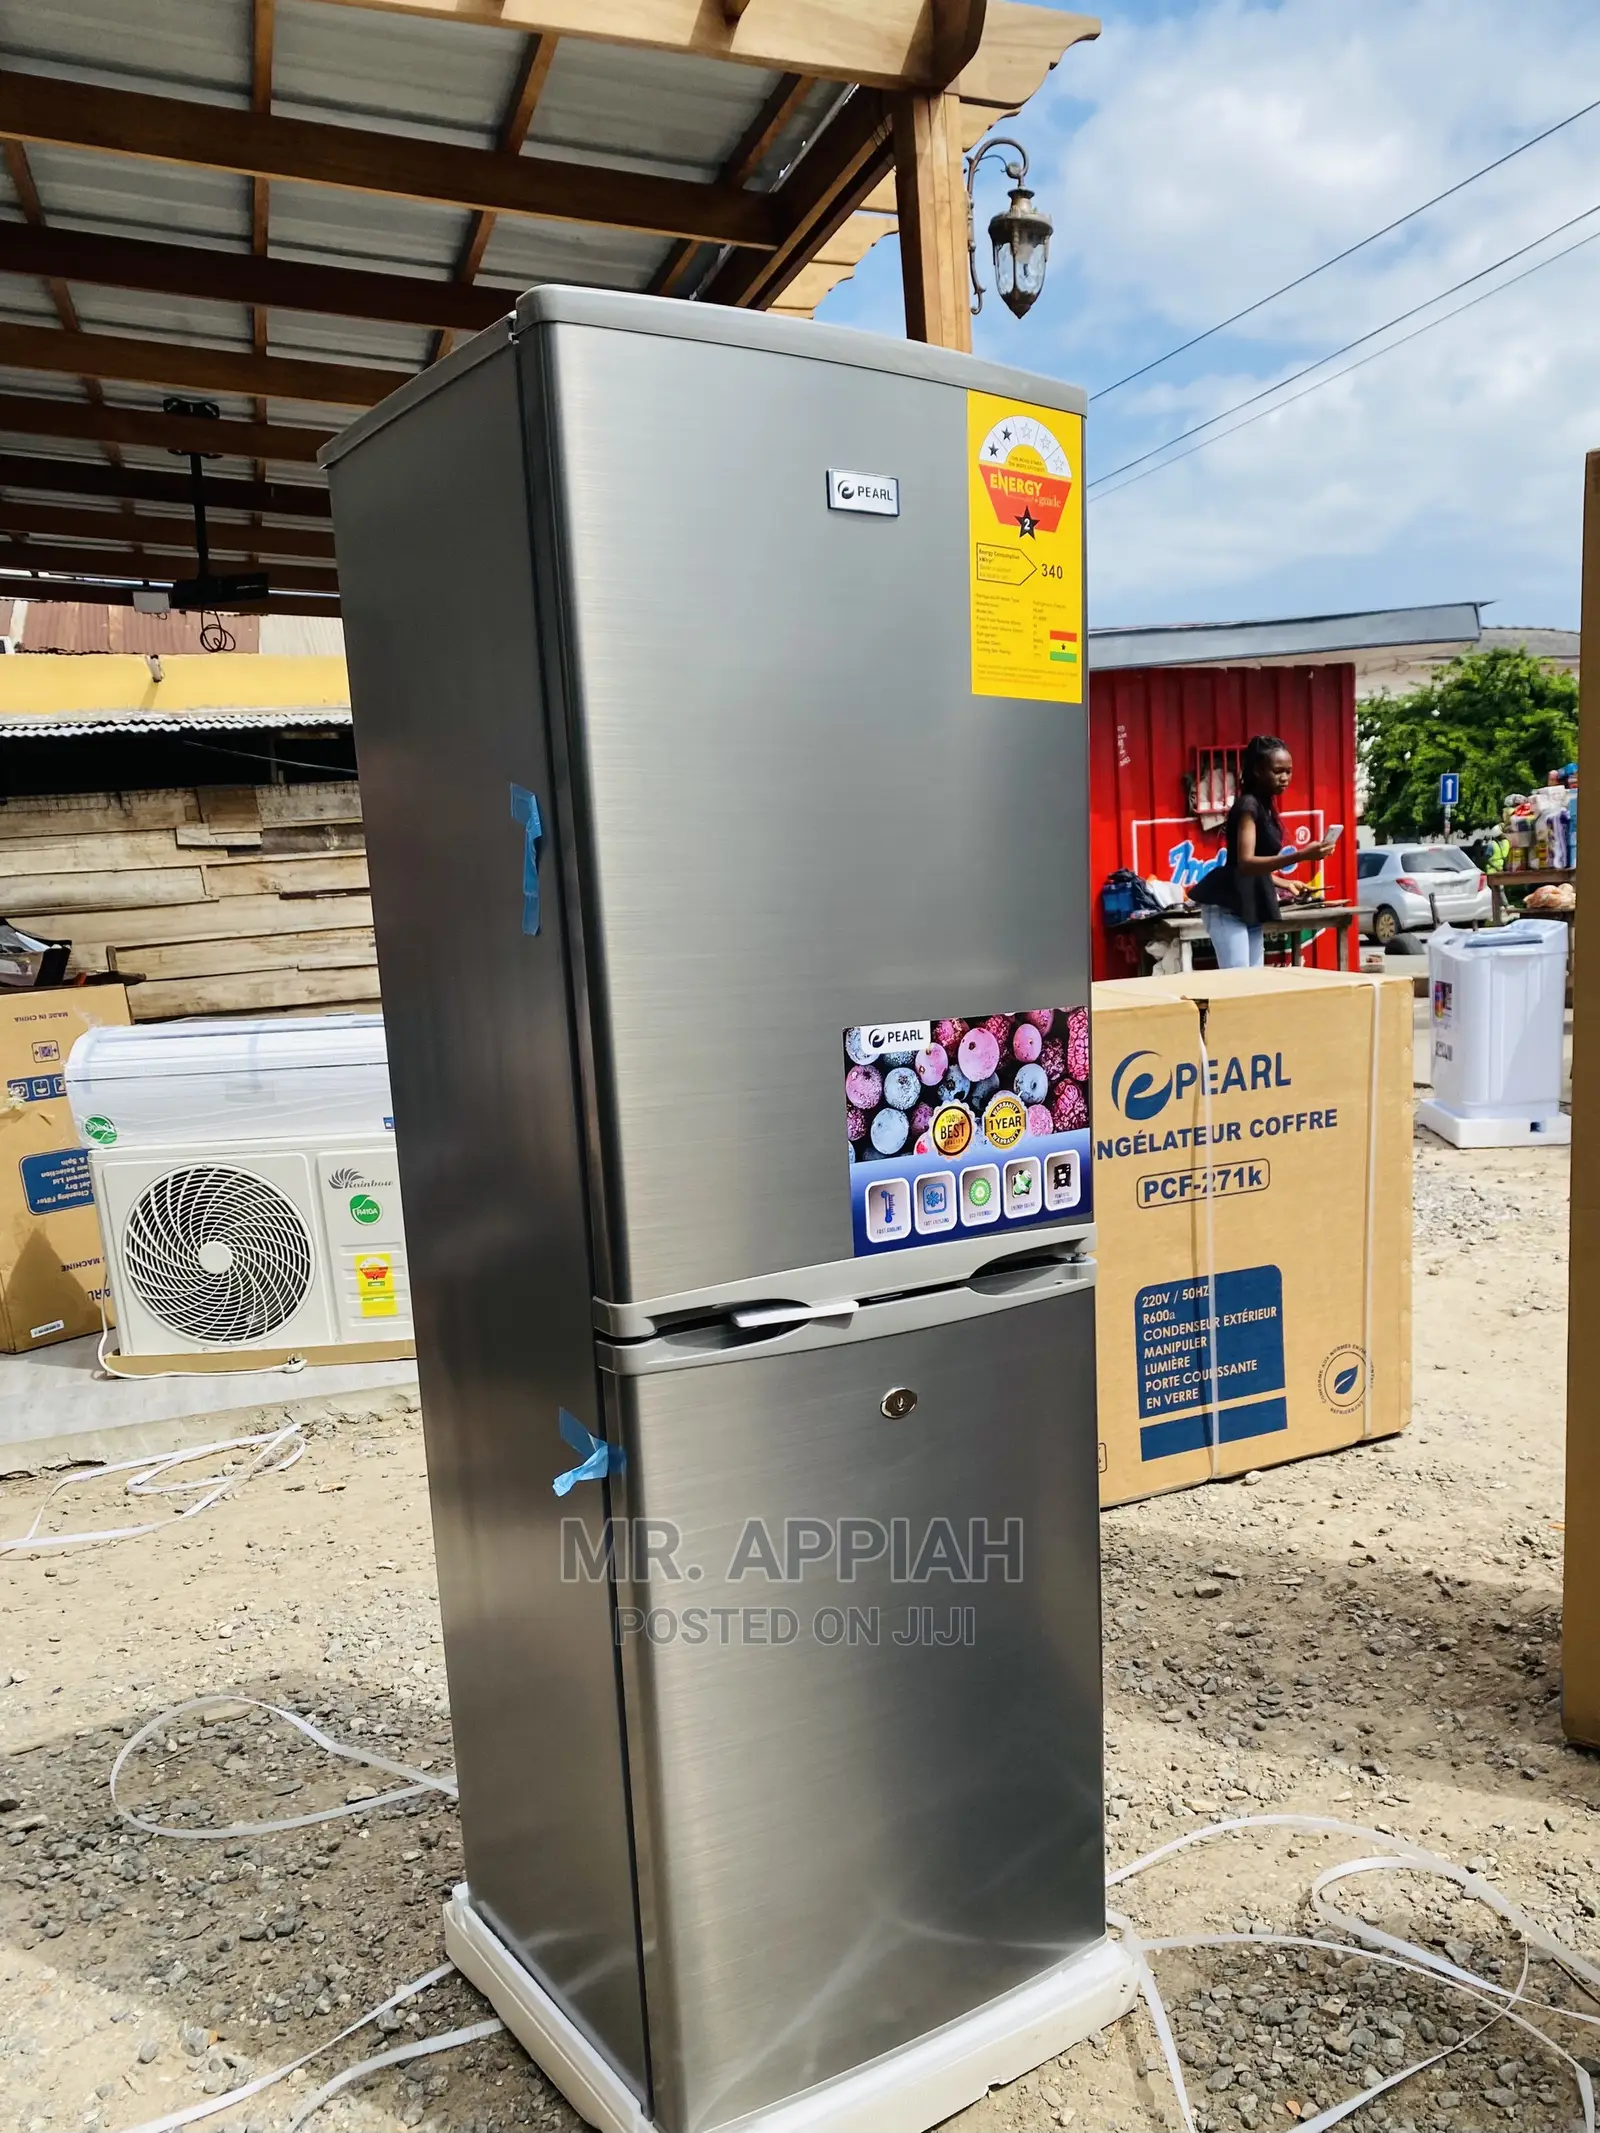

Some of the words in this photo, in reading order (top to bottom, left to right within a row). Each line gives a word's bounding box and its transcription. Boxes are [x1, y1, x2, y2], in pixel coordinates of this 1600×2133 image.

[989, 468, 1043, 497] ENERGY
[857, 486, 894, 501] PEARL
[1023, 518, 1031, 530] 2
[1041, 563, 1063, 580] 340
[887, 1027, 924, 1044] PEARL
[1175, 1052, 1292, 1099] PEARL
[991, 1101, 1020, 1116] WARRANTY
[940, 1122, 966, 1140] BEST
[989, 1120, 994, 1131] 1
[995, 1116, 1022, 1130] YEAR
[991, 1130, 1020, 1145] WARRANTY
[1096, 1121, 1242, 1160] NGÉLATEUR
[1249, 1108, 1338, 1138] COFFRE
[1143, 1166, 1263, 1203] PCF-271k
[60, 1256, 100, 1273] MACHINE
[87, 1287, 111, 1301] ARL
[1142, 1292, 1170, 1308] 220V
[1173, 1290, 1179, 1304] /
[1182, 1285, 1210, 1300] 50HZ
[1143, 1310, 1176, 1325] R600a
[1143, 1317, 1220, 1342] CONDENSEUR
[1223, 1306, 1278, 1327] EXTÉRIEUR
[1144, 1336, 1208, 1359] MANIPULER
[1144, 1355, 1191, 1376] LUMIÈRE
[1145, 1375, 1180, 1393] PORTE
[1183, 1359, 1258, 1384] COUSSANTE
[1146, 1396, 1161, 1409] EN
[1164, 1388, 1199, 1405] VERRE
